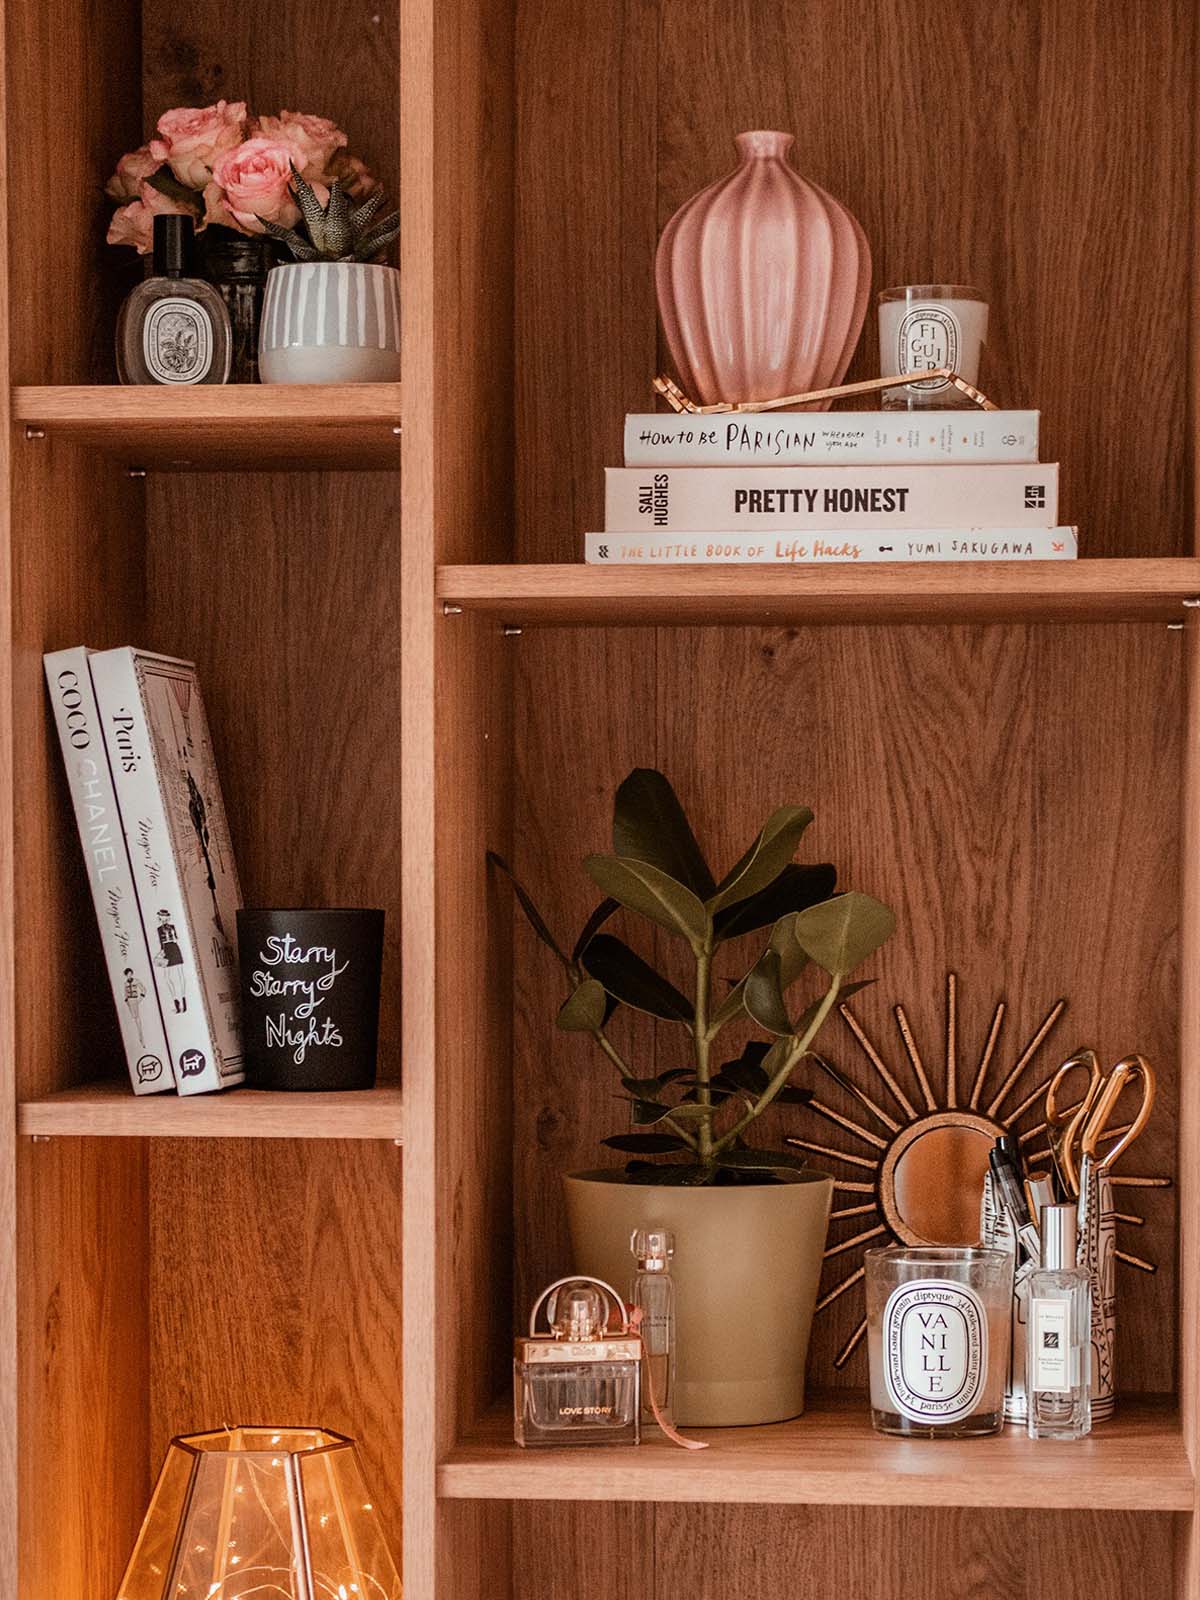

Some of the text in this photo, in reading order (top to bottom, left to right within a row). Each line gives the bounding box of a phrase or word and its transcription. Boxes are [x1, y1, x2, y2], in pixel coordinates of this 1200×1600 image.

[920, 324, 936, 340] FI
[911, 339, 941, 361] GUI
[726, 422, 816, 456] PARISIAN
[638, 486, 653, 514] SALI
[654, 473, 669, 526] HUGHES
[734, 488, 909, 513] PRETTY HONEST
[621, 538, 1033, 562] THE LITTLE BOOK OF Life Hacks YUMI SAKUGAWA
[112, 707, 141, 773] Paris
[57, 670, 119, 882] COCO CHANEL
[260, 932, 350, 990] Starry
[250, 970, 325, 1018] Starry
[265, 1013, 343, 1064] Nights
[913, 1291, 954, 1302] diptyque
[893, 1297, 912, 1328] germain
[918, 1312, 948, 1329] VA
[965, 1303, 979, 1347] boulevard
[921, 1333, 948, 1350] NI
[923, 1355, 951, 1371] LL
[929, 1376, 944, 1392] E
[957, 1371, 976, 1404] germain
[559, 1406, 612, 1415] LOVE STORY
